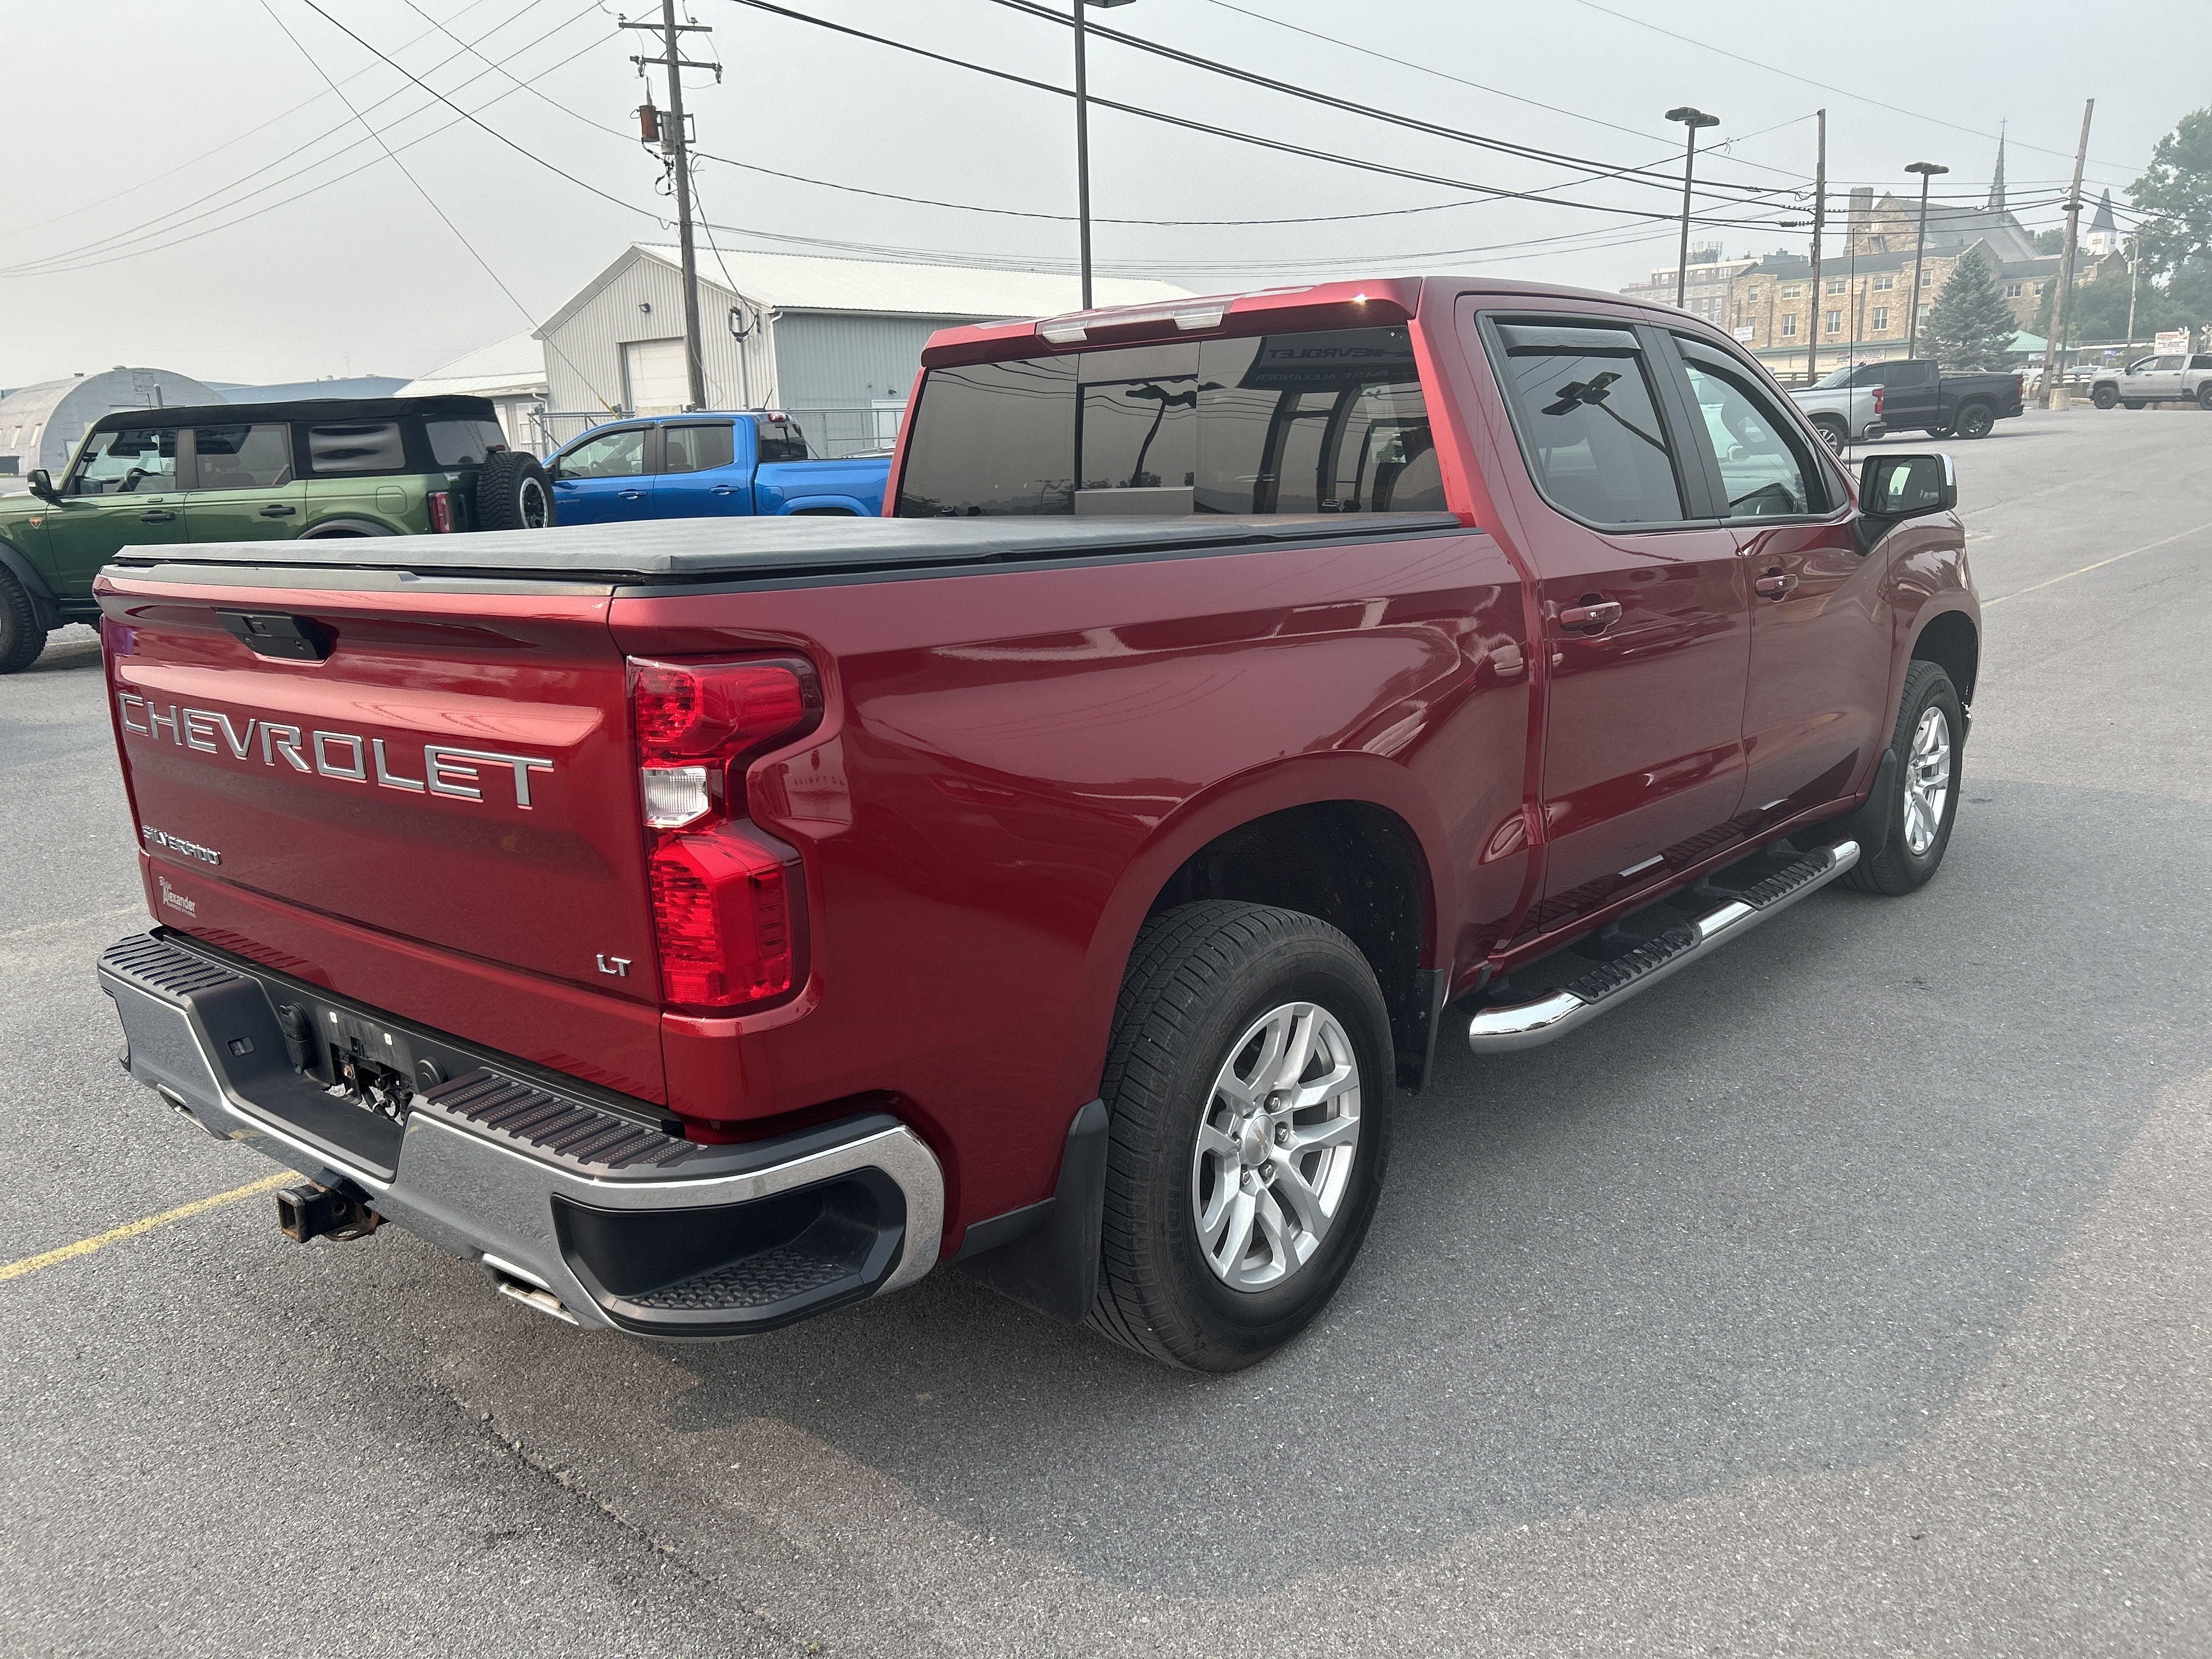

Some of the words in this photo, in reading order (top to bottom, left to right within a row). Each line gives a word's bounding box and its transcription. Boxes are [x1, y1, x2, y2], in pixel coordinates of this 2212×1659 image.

[119, 693, 554, 807] CHEVROLET
[142, 825, 222, 865] SILVERADO
[162, 887, 196, 913] Alexander
[596, 953, 632, 977] LT
